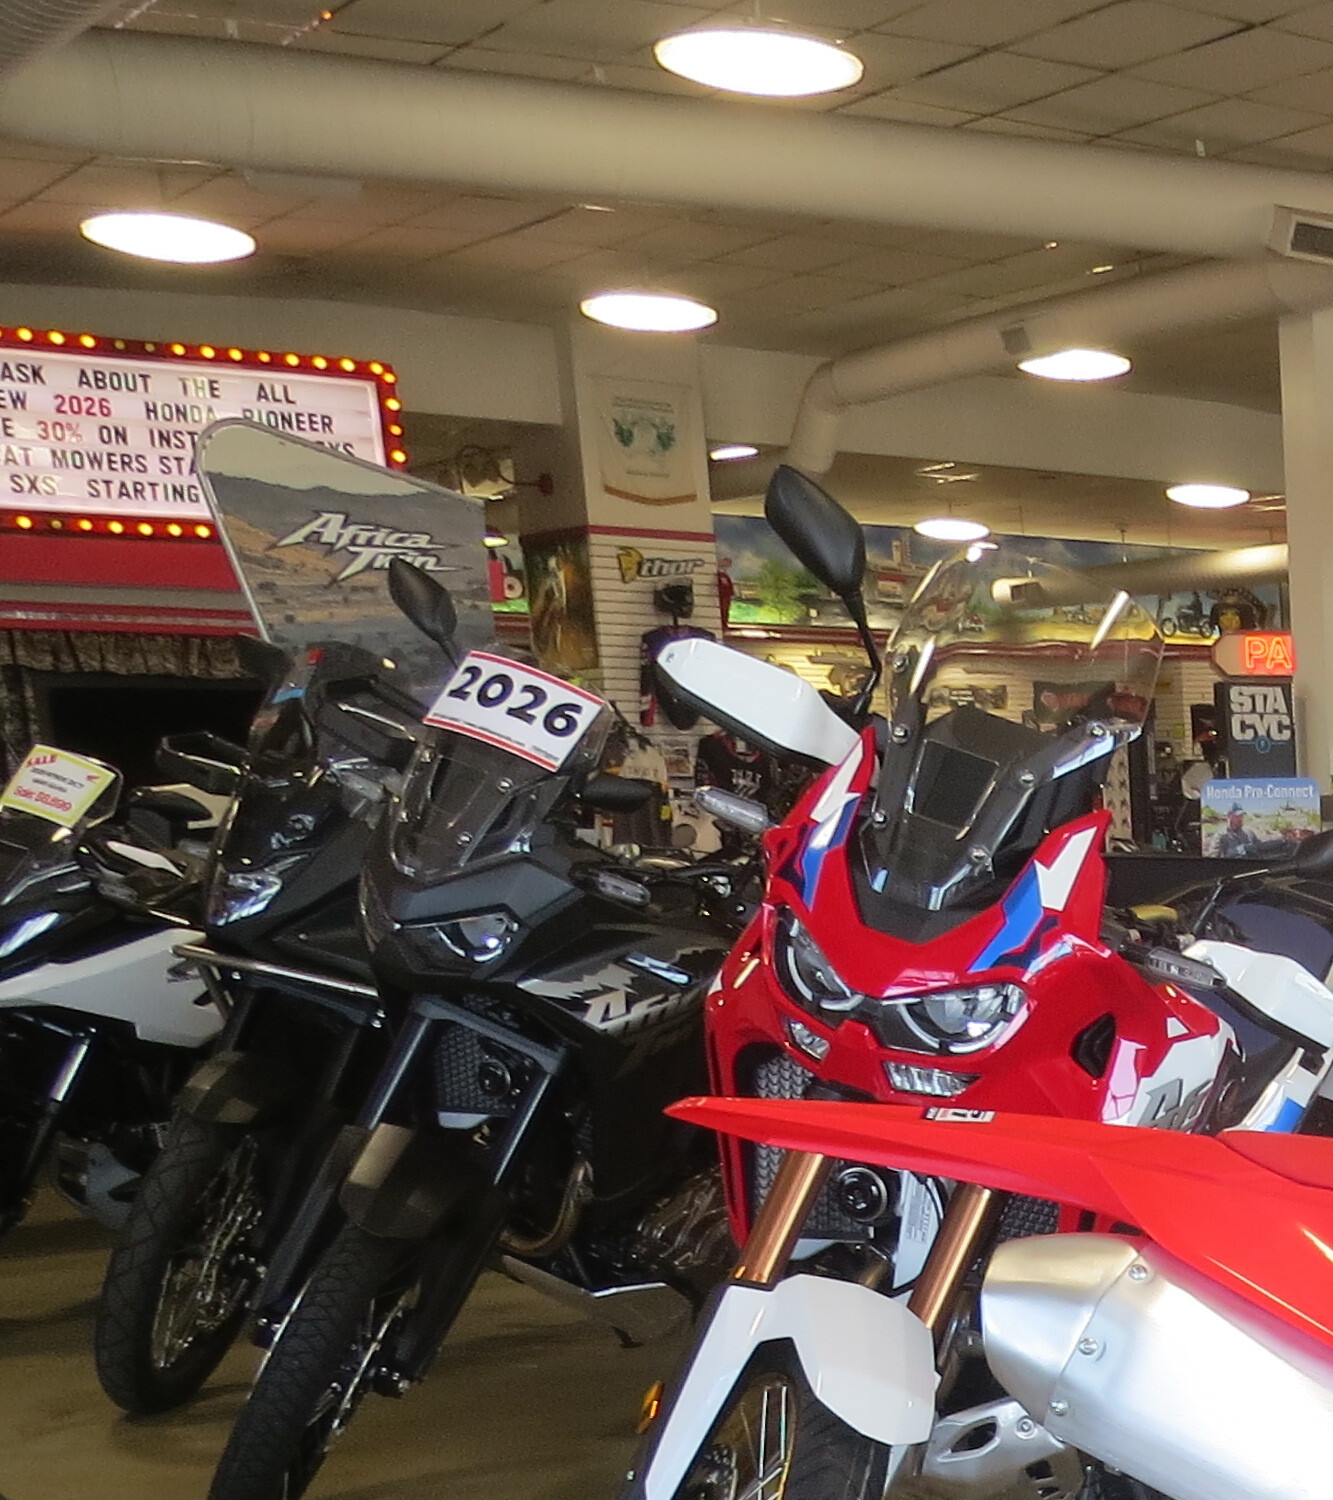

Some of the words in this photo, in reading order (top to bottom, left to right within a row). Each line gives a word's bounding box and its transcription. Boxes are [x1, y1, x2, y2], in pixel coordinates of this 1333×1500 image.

[1, 362, 46, 386] ASK
[78, 368, 151, 395] ABOUT
[178, 375, 221, 400] THE
[256, 382, 297, 405] ALL
[54, 393, 112, 419] 2026
[145, 401, 217, 426] HONDA
[242, 407, 335, 435] PIONEER
[36, 420, 83, 444] 30%
[99, 425, 129, 446] ON
[51, 449, 148, 475] MOWERS
[10, 473, 60, 497] SXS
[87, 478, 200, 503] STARTING
[273, 510, 452, 550] Africa
[448, 666, 583, 737] 2026
[1206, 785, 1242, 799] Honda
